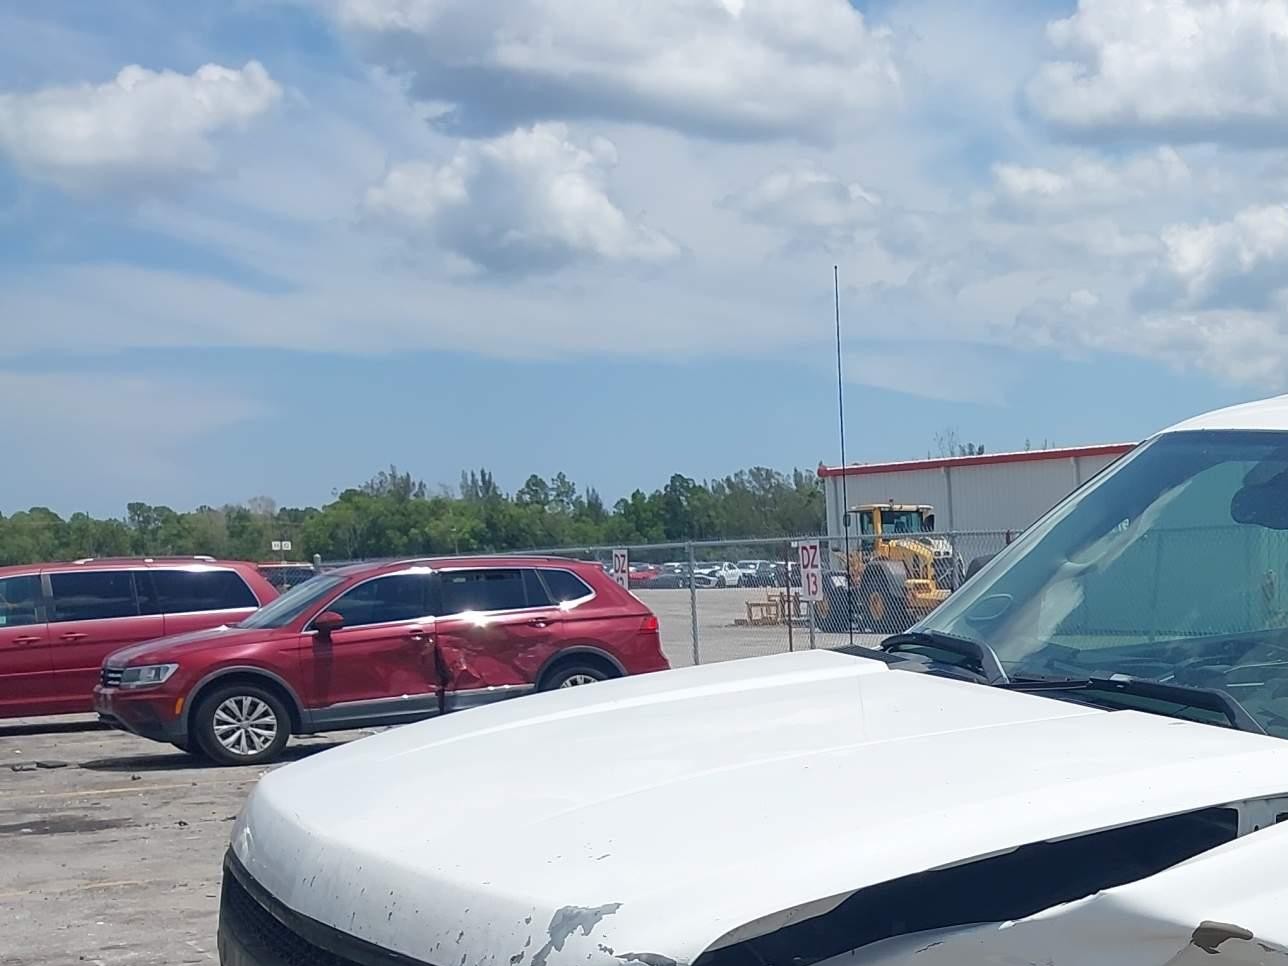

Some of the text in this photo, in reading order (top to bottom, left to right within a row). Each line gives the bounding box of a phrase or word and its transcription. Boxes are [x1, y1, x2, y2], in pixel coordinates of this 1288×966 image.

[614, 553, 626, 574] DZ
[801, 545, 819, 569] DZ
[806, 573, 818, 596] 13
